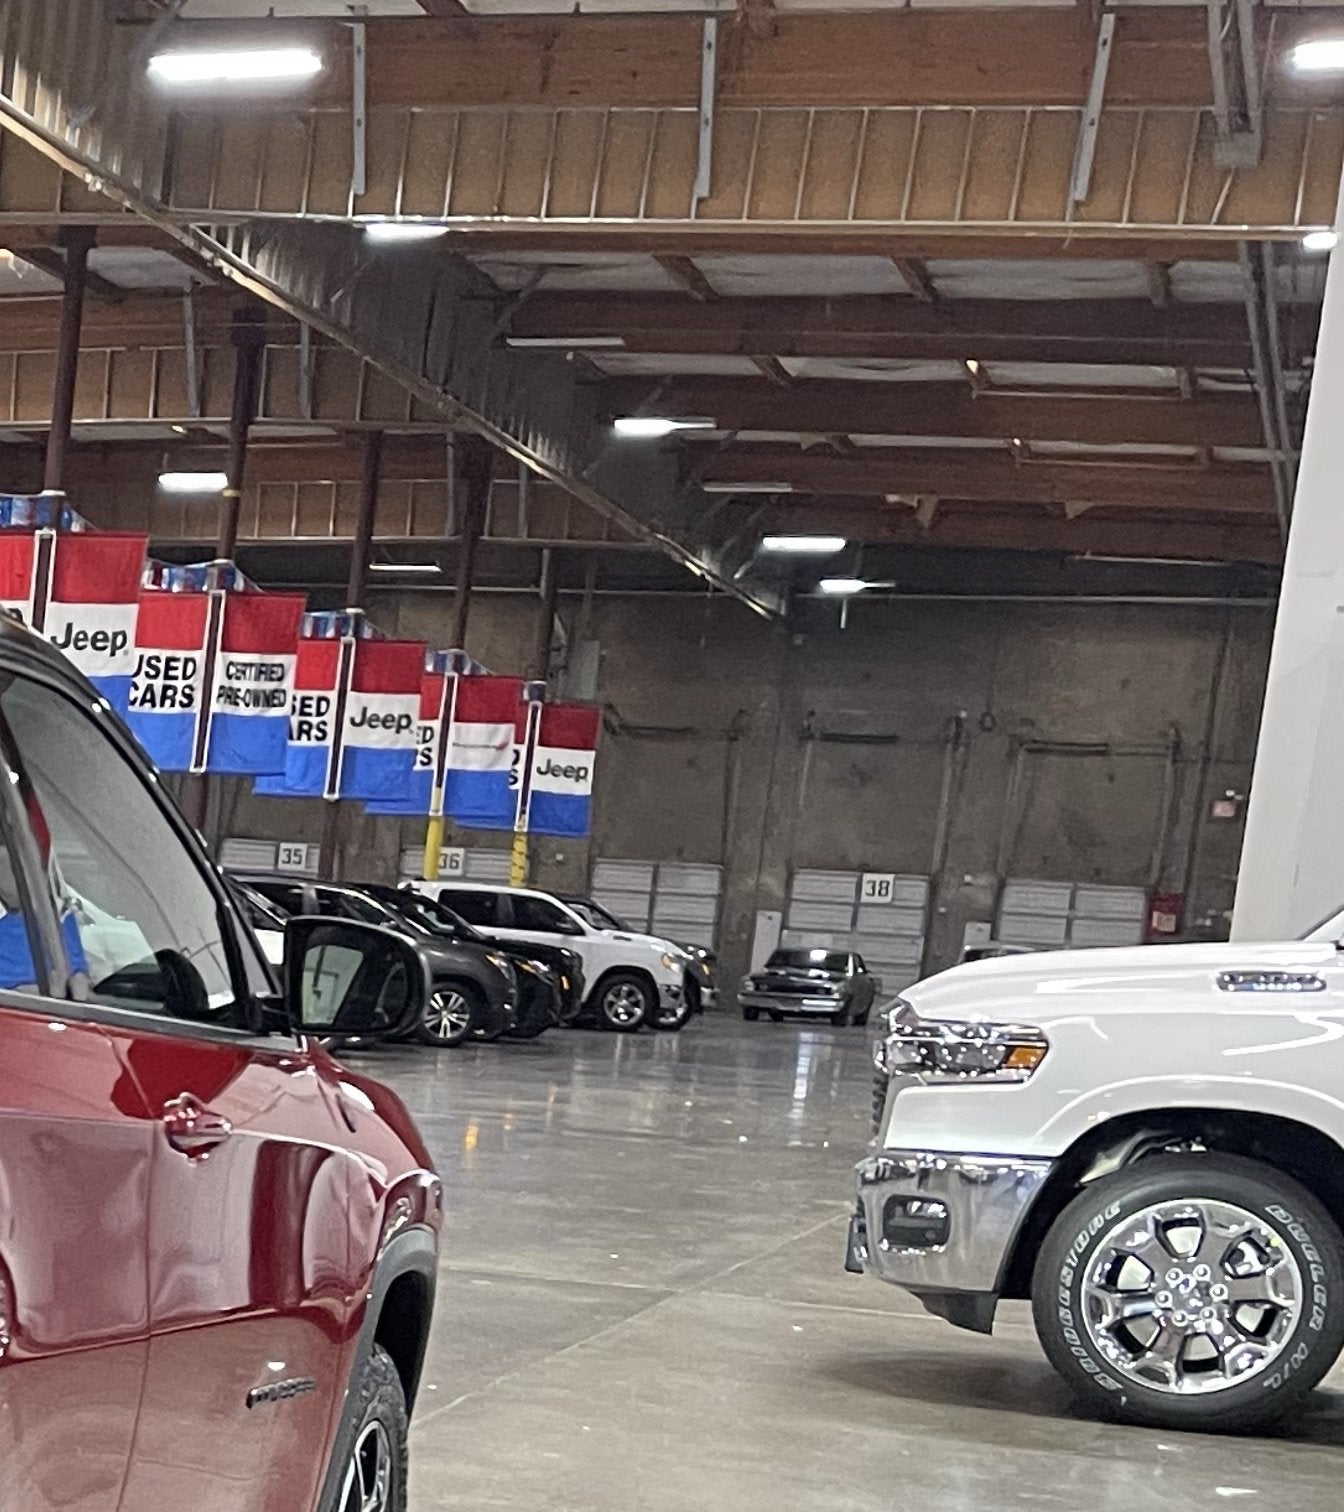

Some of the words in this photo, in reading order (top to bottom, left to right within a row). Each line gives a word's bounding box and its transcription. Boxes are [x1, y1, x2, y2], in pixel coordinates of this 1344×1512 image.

[50, 623, 128, 656] Jeep
[226, 661, 284, 681] CERTIFIED
[216, 685, 286, 708] PRE-OWNED
[350, 707, 412, 734] Jeep
[536, 759, 589, 782] Jeep
[281, 848, 302, 865] 35
[865, 880, 891, 897] 38
